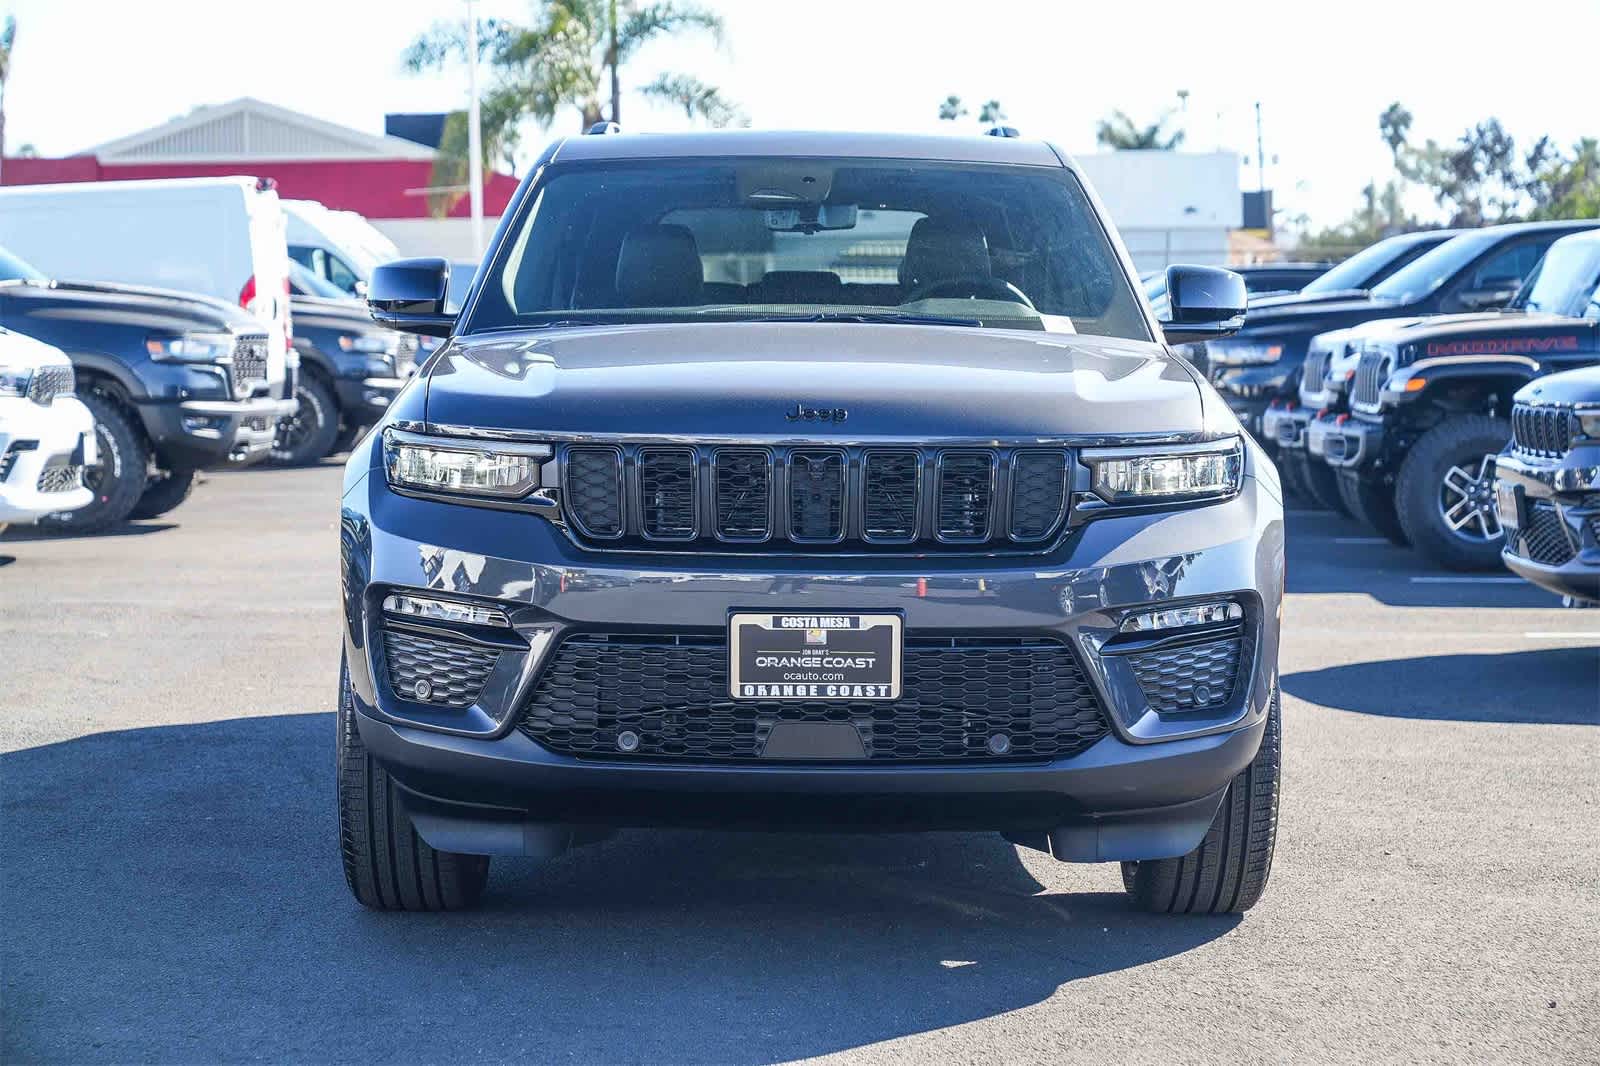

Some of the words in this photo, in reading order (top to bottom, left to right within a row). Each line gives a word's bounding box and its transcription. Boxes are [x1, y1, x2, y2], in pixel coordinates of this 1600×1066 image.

[784, 403, 848, 424] Jeep
[781, 617, 818, 628] COSTA
[818, 617, 851, 628] MESA
[783, 671, 844, 681] ocauto.com
[744, 685, 818, 697] ORANGE
[826, 685, 889, 697] COAST
